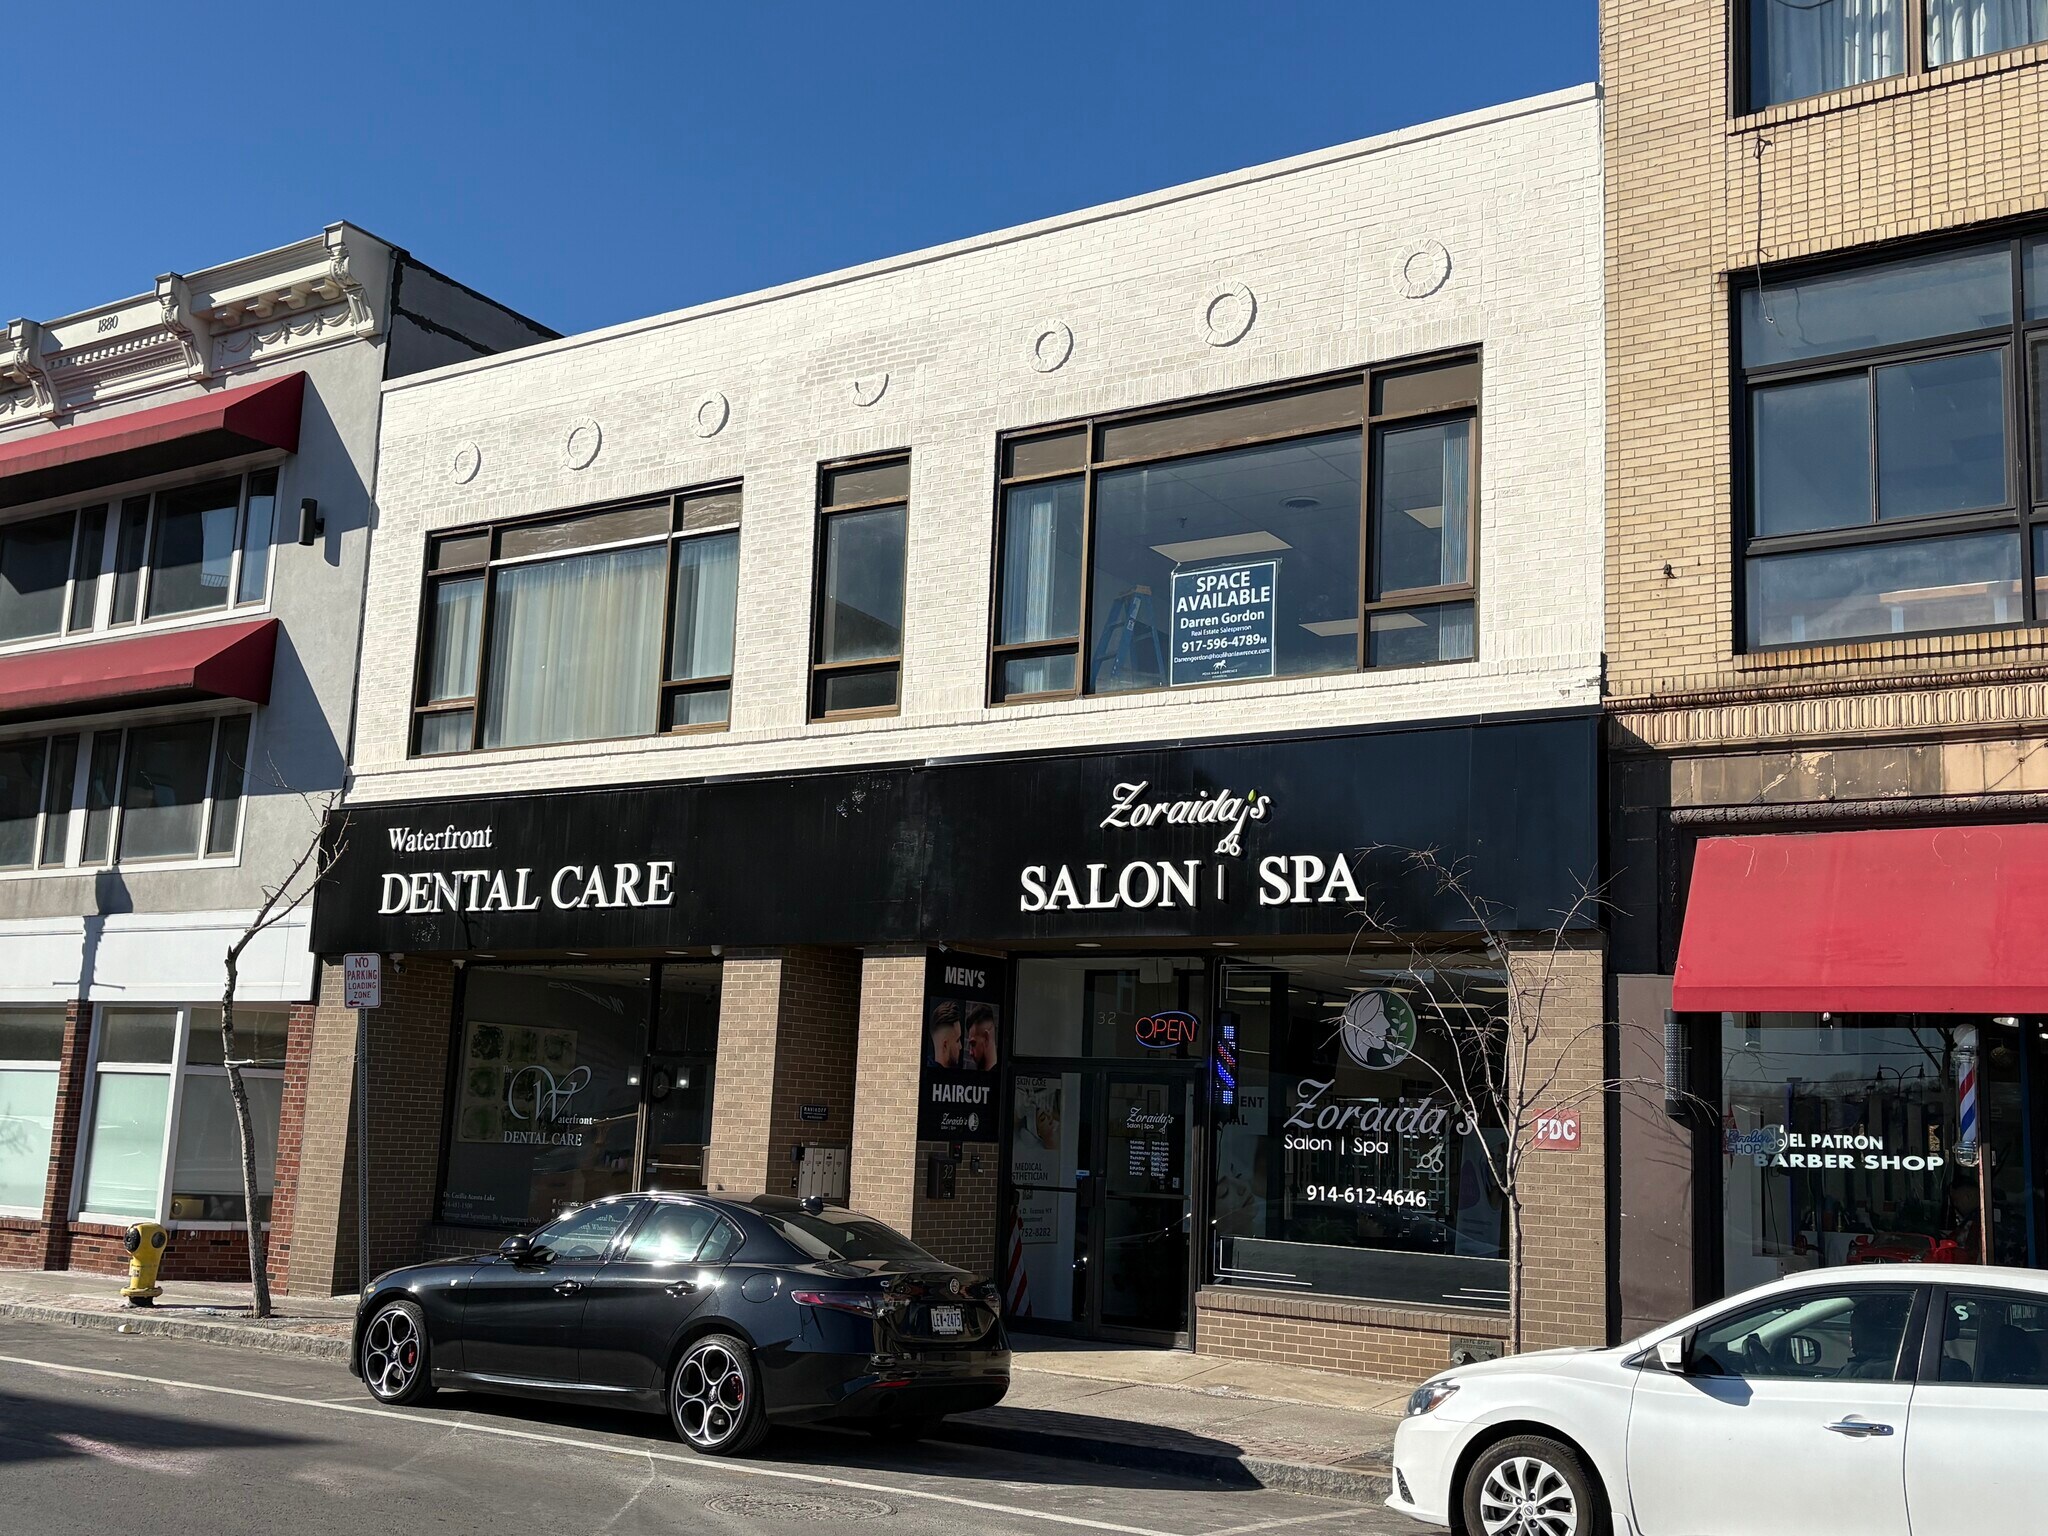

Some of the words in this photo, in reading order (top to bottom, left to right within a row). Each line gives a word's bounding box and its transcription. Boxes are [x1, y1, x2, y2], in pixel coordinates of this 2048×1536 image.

[97, 315, 118, 333] 1880
[1196, 571, 1250, 593] SPACE
[1176, 586, 1270, 613] AVAILABLE
[1180, 616, 1218, 629] Darren
[1221, 610, 1264, 624] Gordon
[1203, 628, 1219, 636] Estate
[1100, 780, 1271, 829] Zoraida's
[388, 824, 492, 852] Waterfront
[378, 868, 542, 914] DENTAL
[550, 862, 676, 909] CARE
[1020, 860, 1202, 912] SALON
[1259, 853, 1365, 906] SPA
[354, 958, 369, 968] NO
[347, 970, 377, 980] PARKING
[944, 966, 985, 988] MEN'S
[348, 982, 376, 990] LOADING
[354, 991, 371, 999] ZONE
[1097, 1011, 1116, 1024] 32
[1135, 1017, 1195, 1041] OPEN
[1017, 1078, 1030, 1086] SKIN
[1032, 1078, 1046, 1087] CARE
[932, 1084, 990, 1105] HAIRCUT
[1126, 1107, 1174, 1124] Zoraida's
[1283, 1078, 1479, 1136] Zoraida's
[1538, 1118, 1576, 1140] FDC
[1728, 1128, 1772, 1143] Barber
[504, 1131, 550, 1144] DENTAL
[551, 1132, 583, 1147] CARE
[1284, 1134, 1332, 1151] Salon
[1353, 1137, 1389, 1156] Spa
[1811, 1133, 1884, 1150] PATRON
[1727, 1143, 1762, 1154] SHOP
[1015, 1162, 1042, 1171] MEDICAL
[1753, 1153, 1856, 1169] BARBER
[1864, 1155, 1944, 1171] SHOP
[943, 1164, 953, 1179] 32
[1012, 1172, 1048, 1181] STHETICIAN
[1306, 1185, 1427, 1207] 914-612-4646
